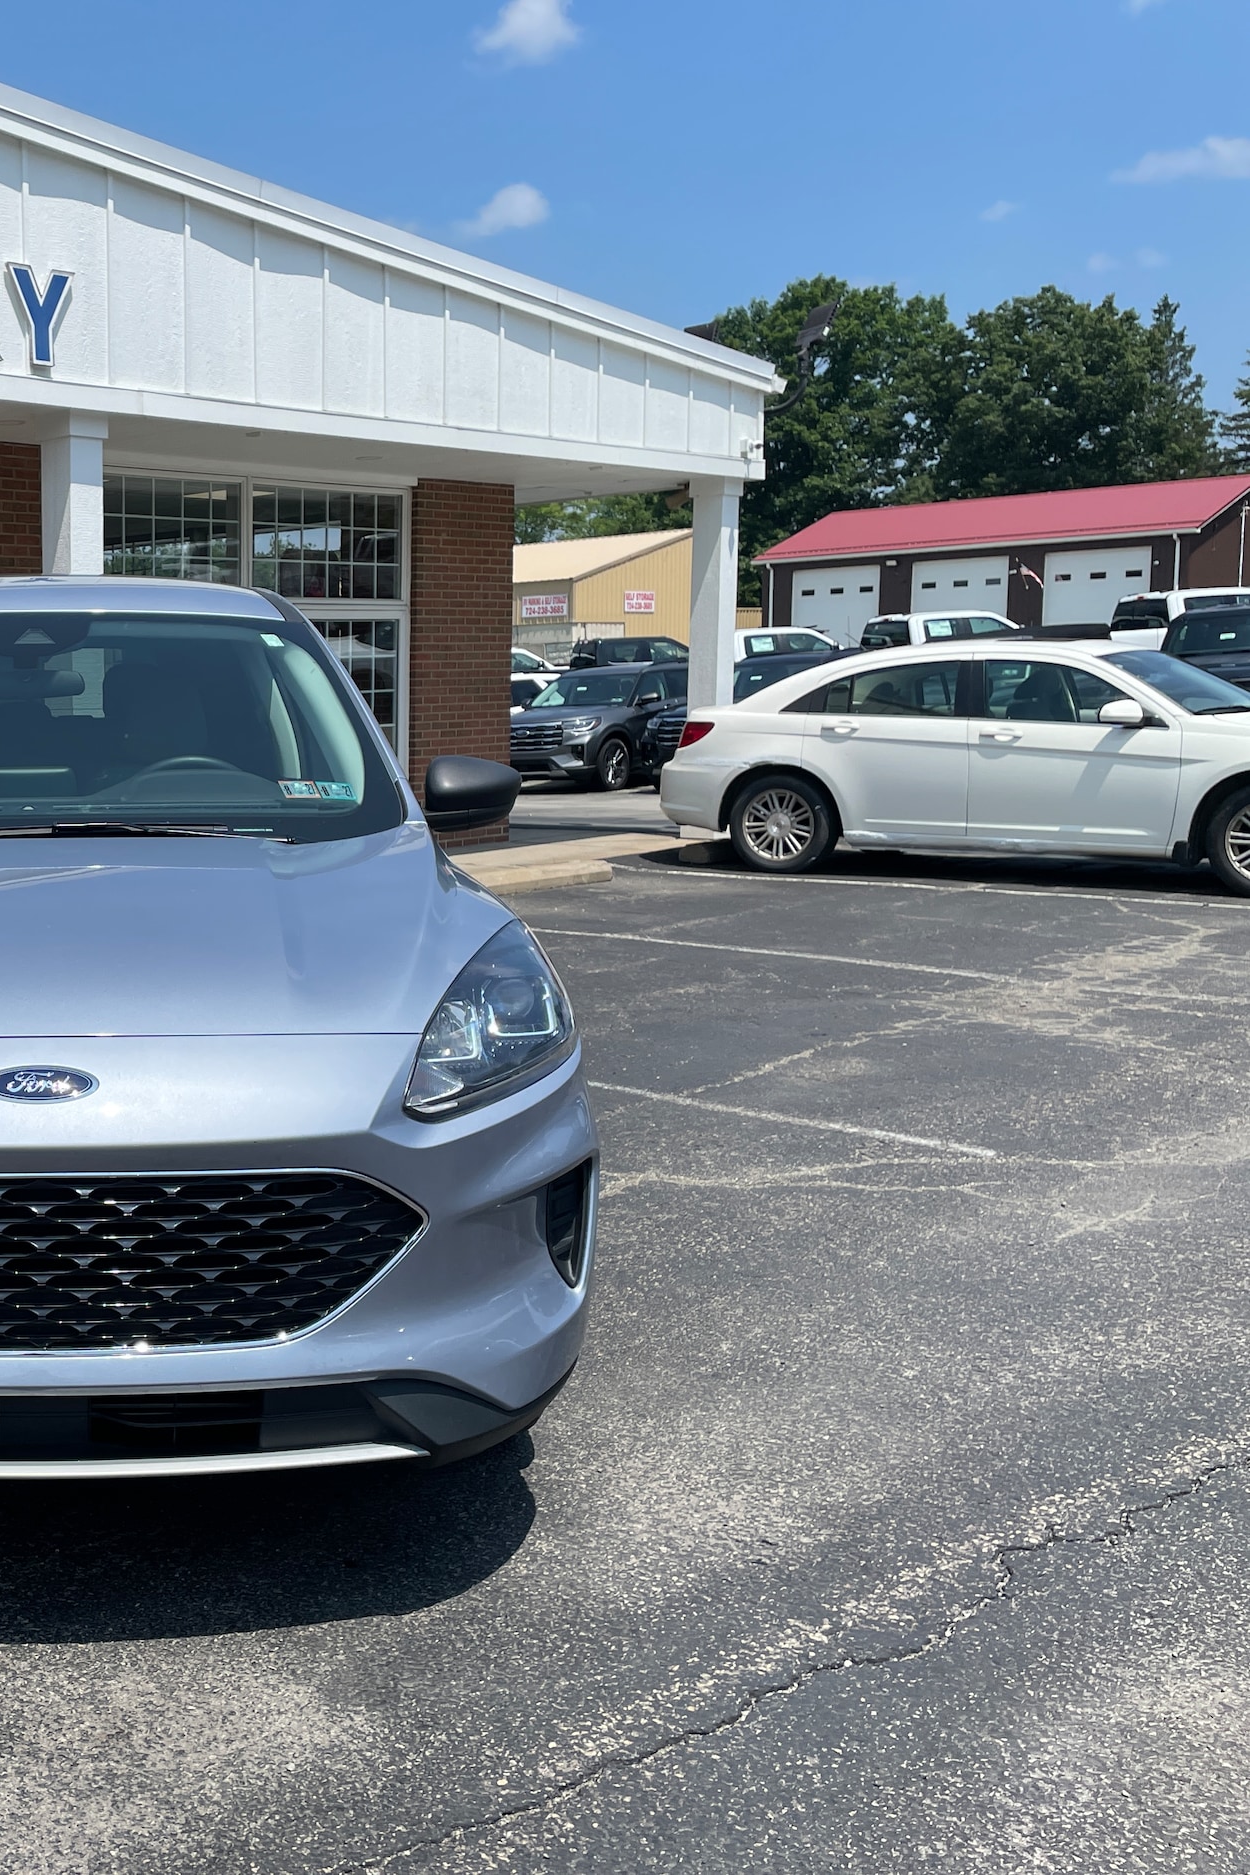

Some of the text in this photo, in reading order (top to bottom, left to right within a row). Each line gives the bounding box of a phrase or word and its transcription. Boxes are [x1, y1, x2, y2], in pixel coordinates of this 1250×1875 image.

[636, 593, 654, 601] STORAGE
[525, 605, 564, 616] 724-238-3685
[6, 1071, 70, 1093] Ford
